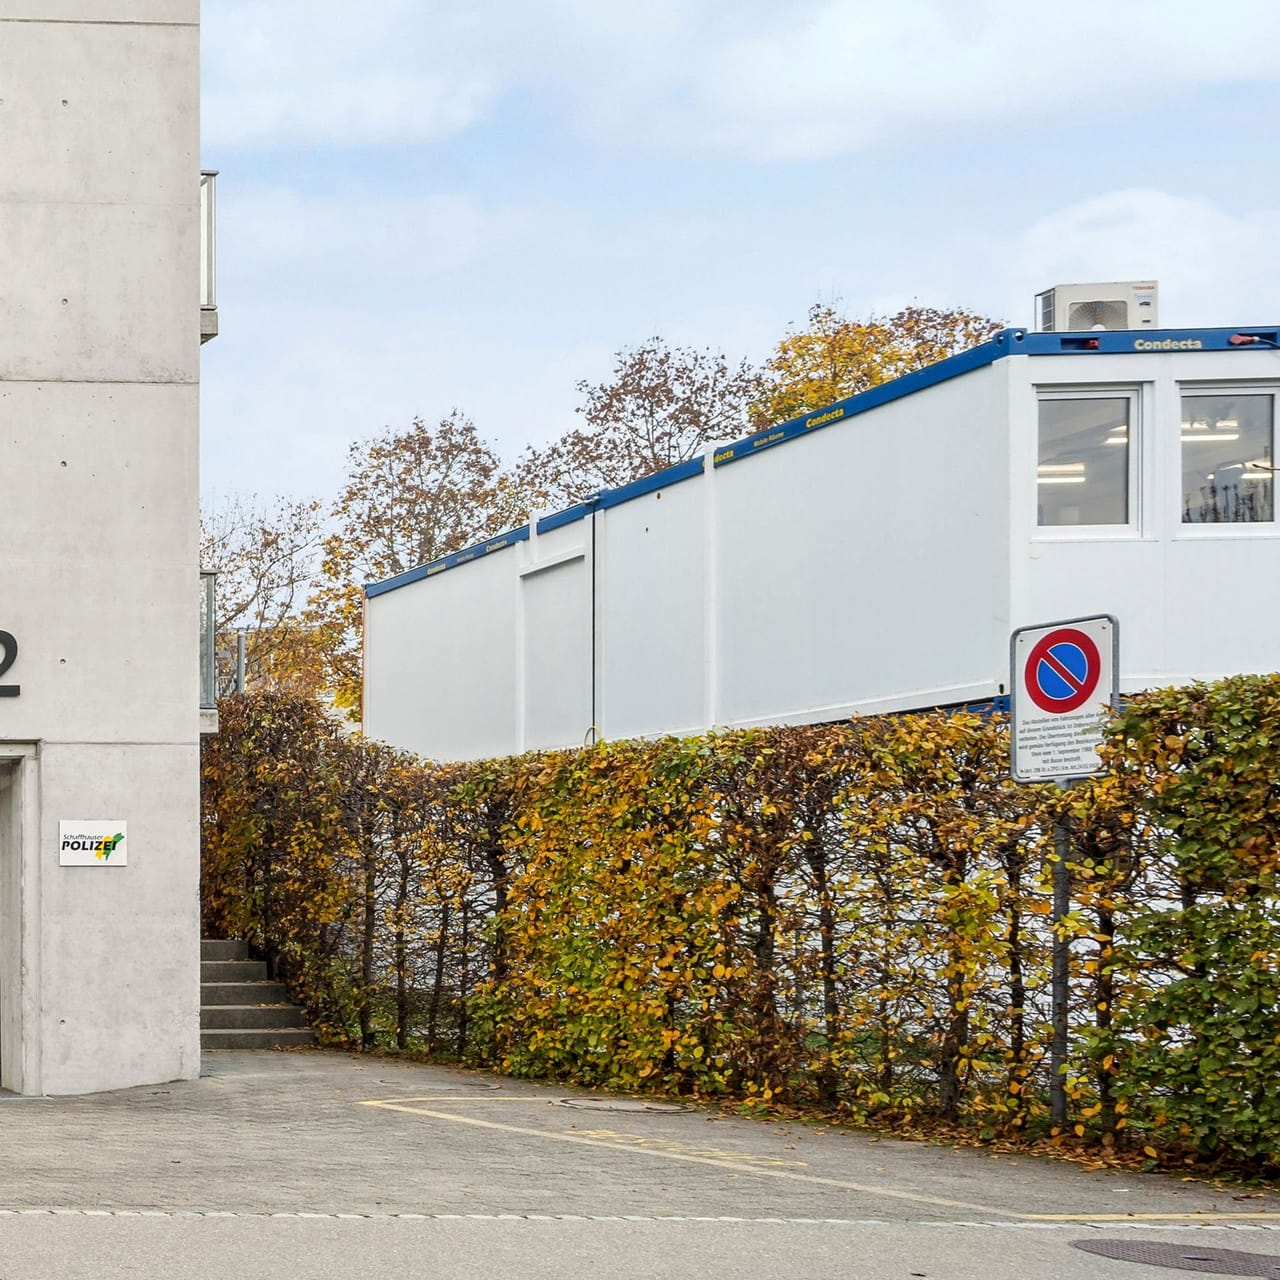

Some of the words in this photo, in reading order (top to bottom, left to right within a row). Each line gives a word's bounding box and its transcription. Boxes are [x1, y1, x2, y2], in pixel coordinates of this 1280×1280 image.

[1134, 338, 1203, 351] Condecta
[806, 408, 845, 428] Condecta
[61, 840, 118, 851] POLIZEI
